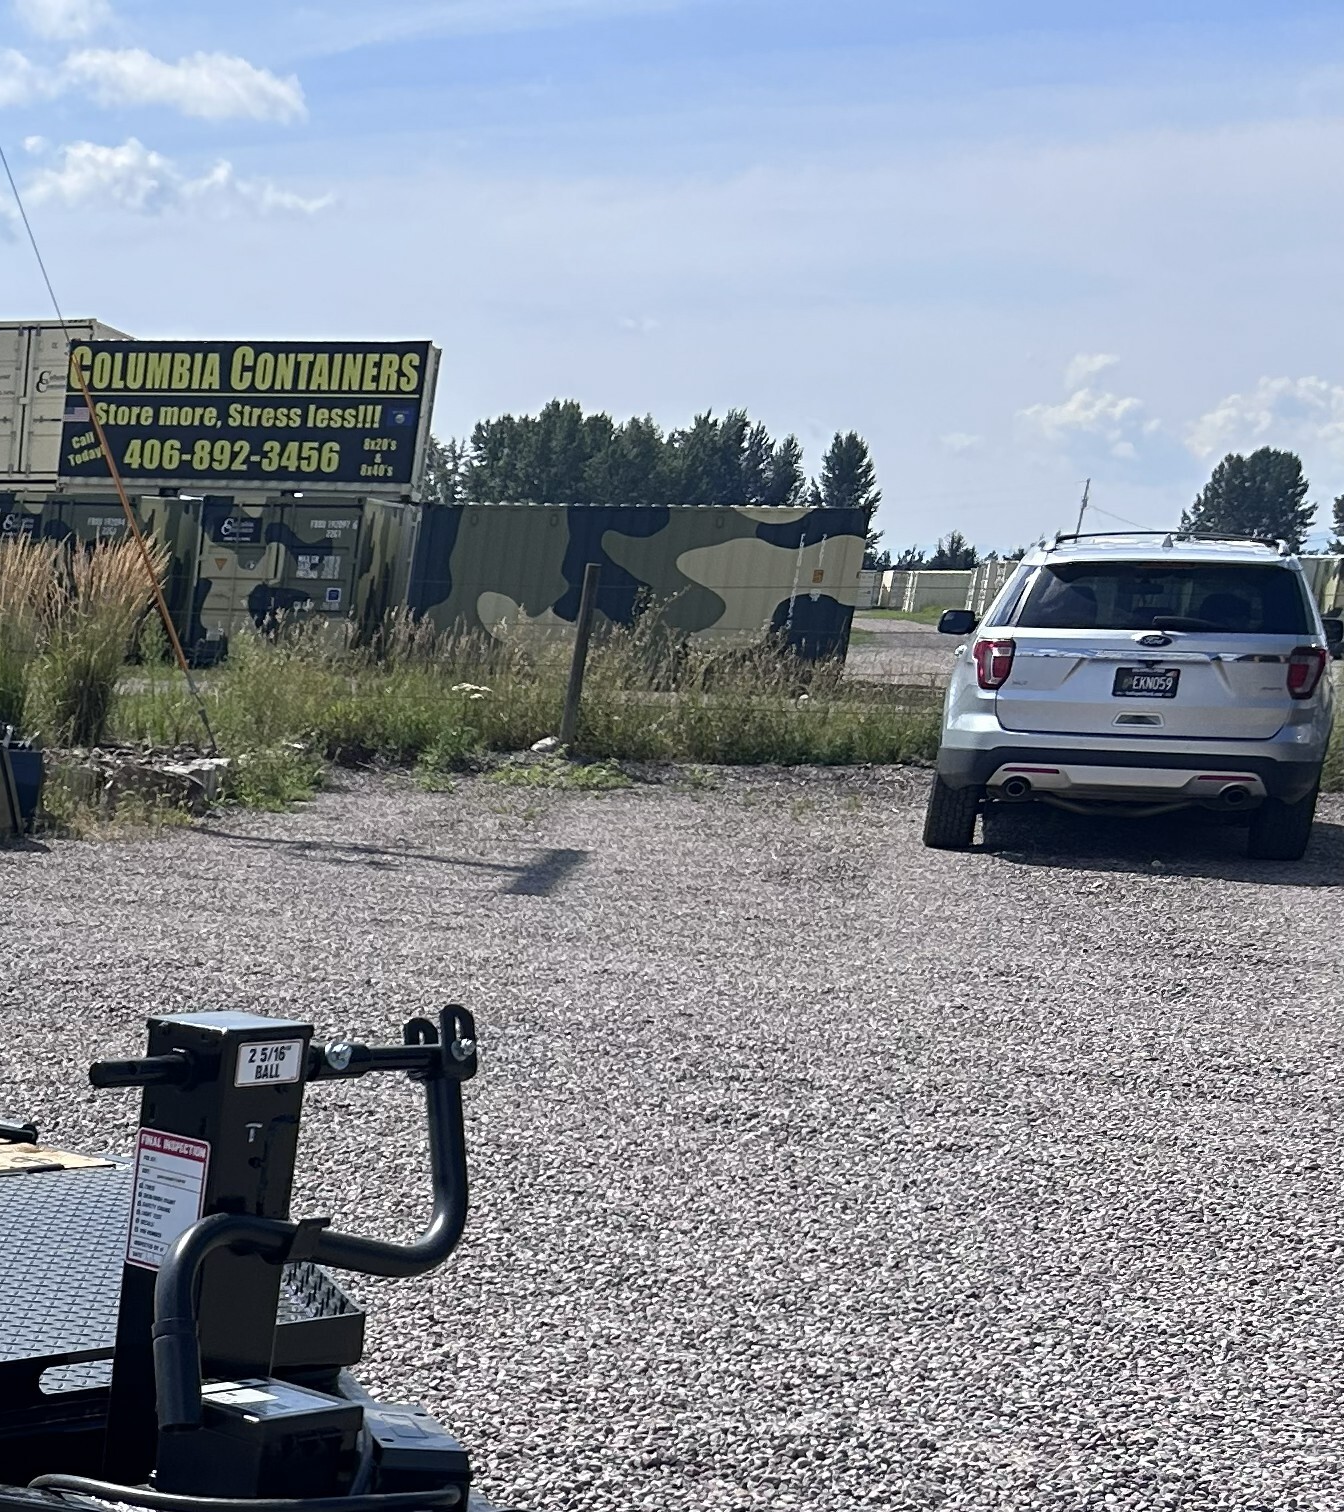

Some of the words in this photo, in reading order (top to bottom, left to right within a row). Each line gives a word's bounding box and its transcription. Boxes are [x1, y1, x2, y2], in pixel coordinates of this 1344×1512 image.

[69, 345, 221, 390] COLUMBIA
[230, 345, 420, 392] CONTAINERS
[95, 402, 154, 426] Store
[158, 406, 222, 428] more,
[228, 403, 302, 428] Stress
[306, 404, 382, 428] less!!!
[71, 431, 95, 449] Call
[363, 438, 397, 451] 8x20's
[123, 438, 341, 473] 406-892-3456
[1143, 636, 1165, 645] Ford
[248, 1048, 257, 1064] 2
[254, 1063, 280, 1080] BALL
[141, 1134, 162, 1149] FINAL
[163, 1139, 206, 1159] INSPECTION
